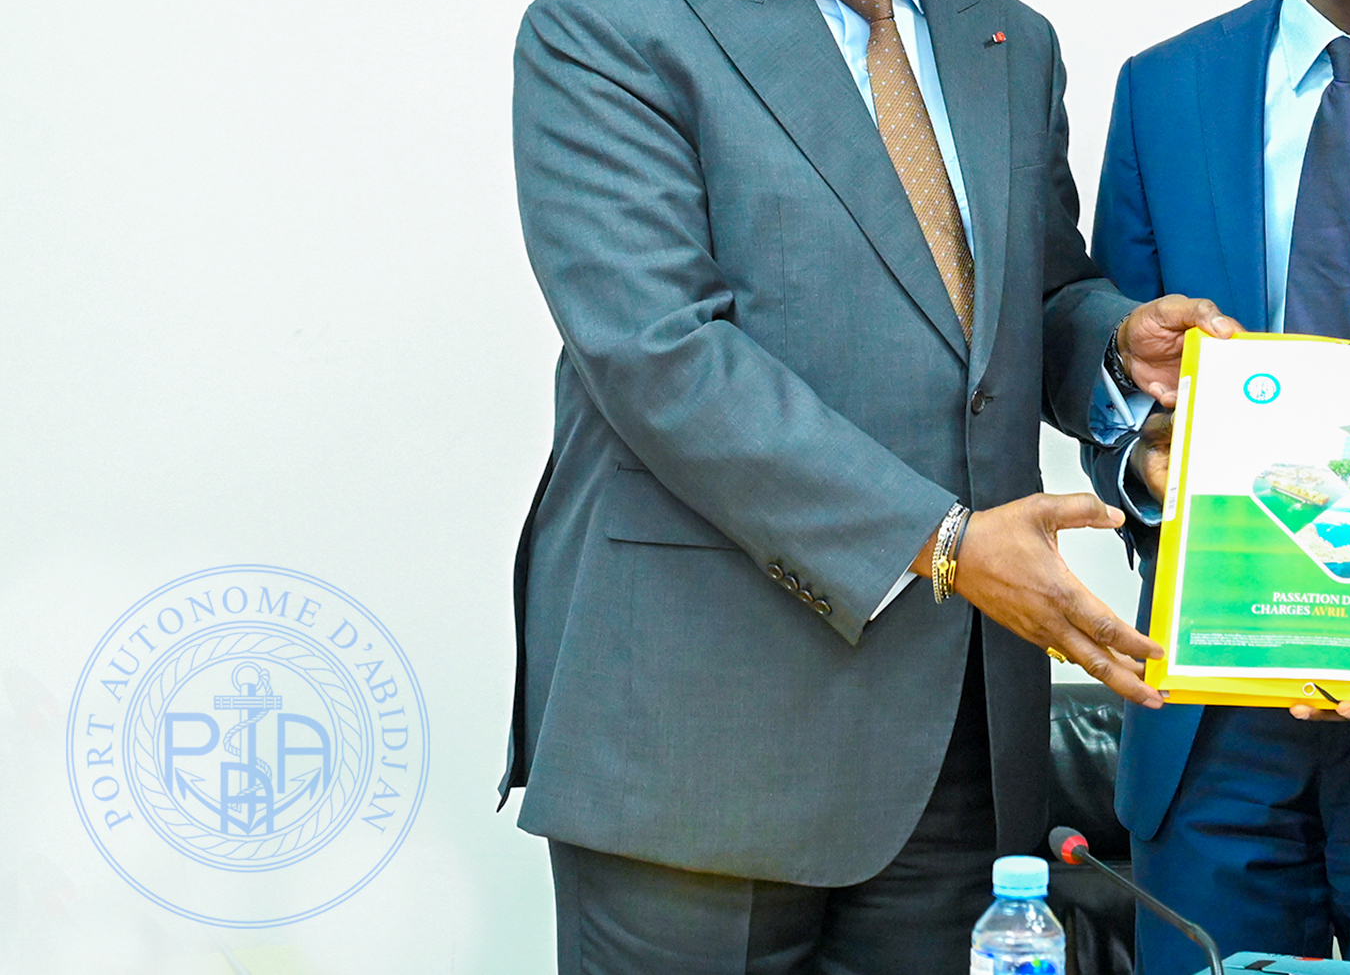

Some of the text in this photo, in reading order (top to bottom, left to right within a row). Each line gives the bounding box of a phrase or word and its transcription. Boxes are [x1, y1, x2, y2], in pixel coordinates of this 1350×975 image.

[1272, 591, 1340, 605] PASSATION
[1250, 603, 1311, 616] CHARGES
[1311, 605, 1348, 618] AVRIL
